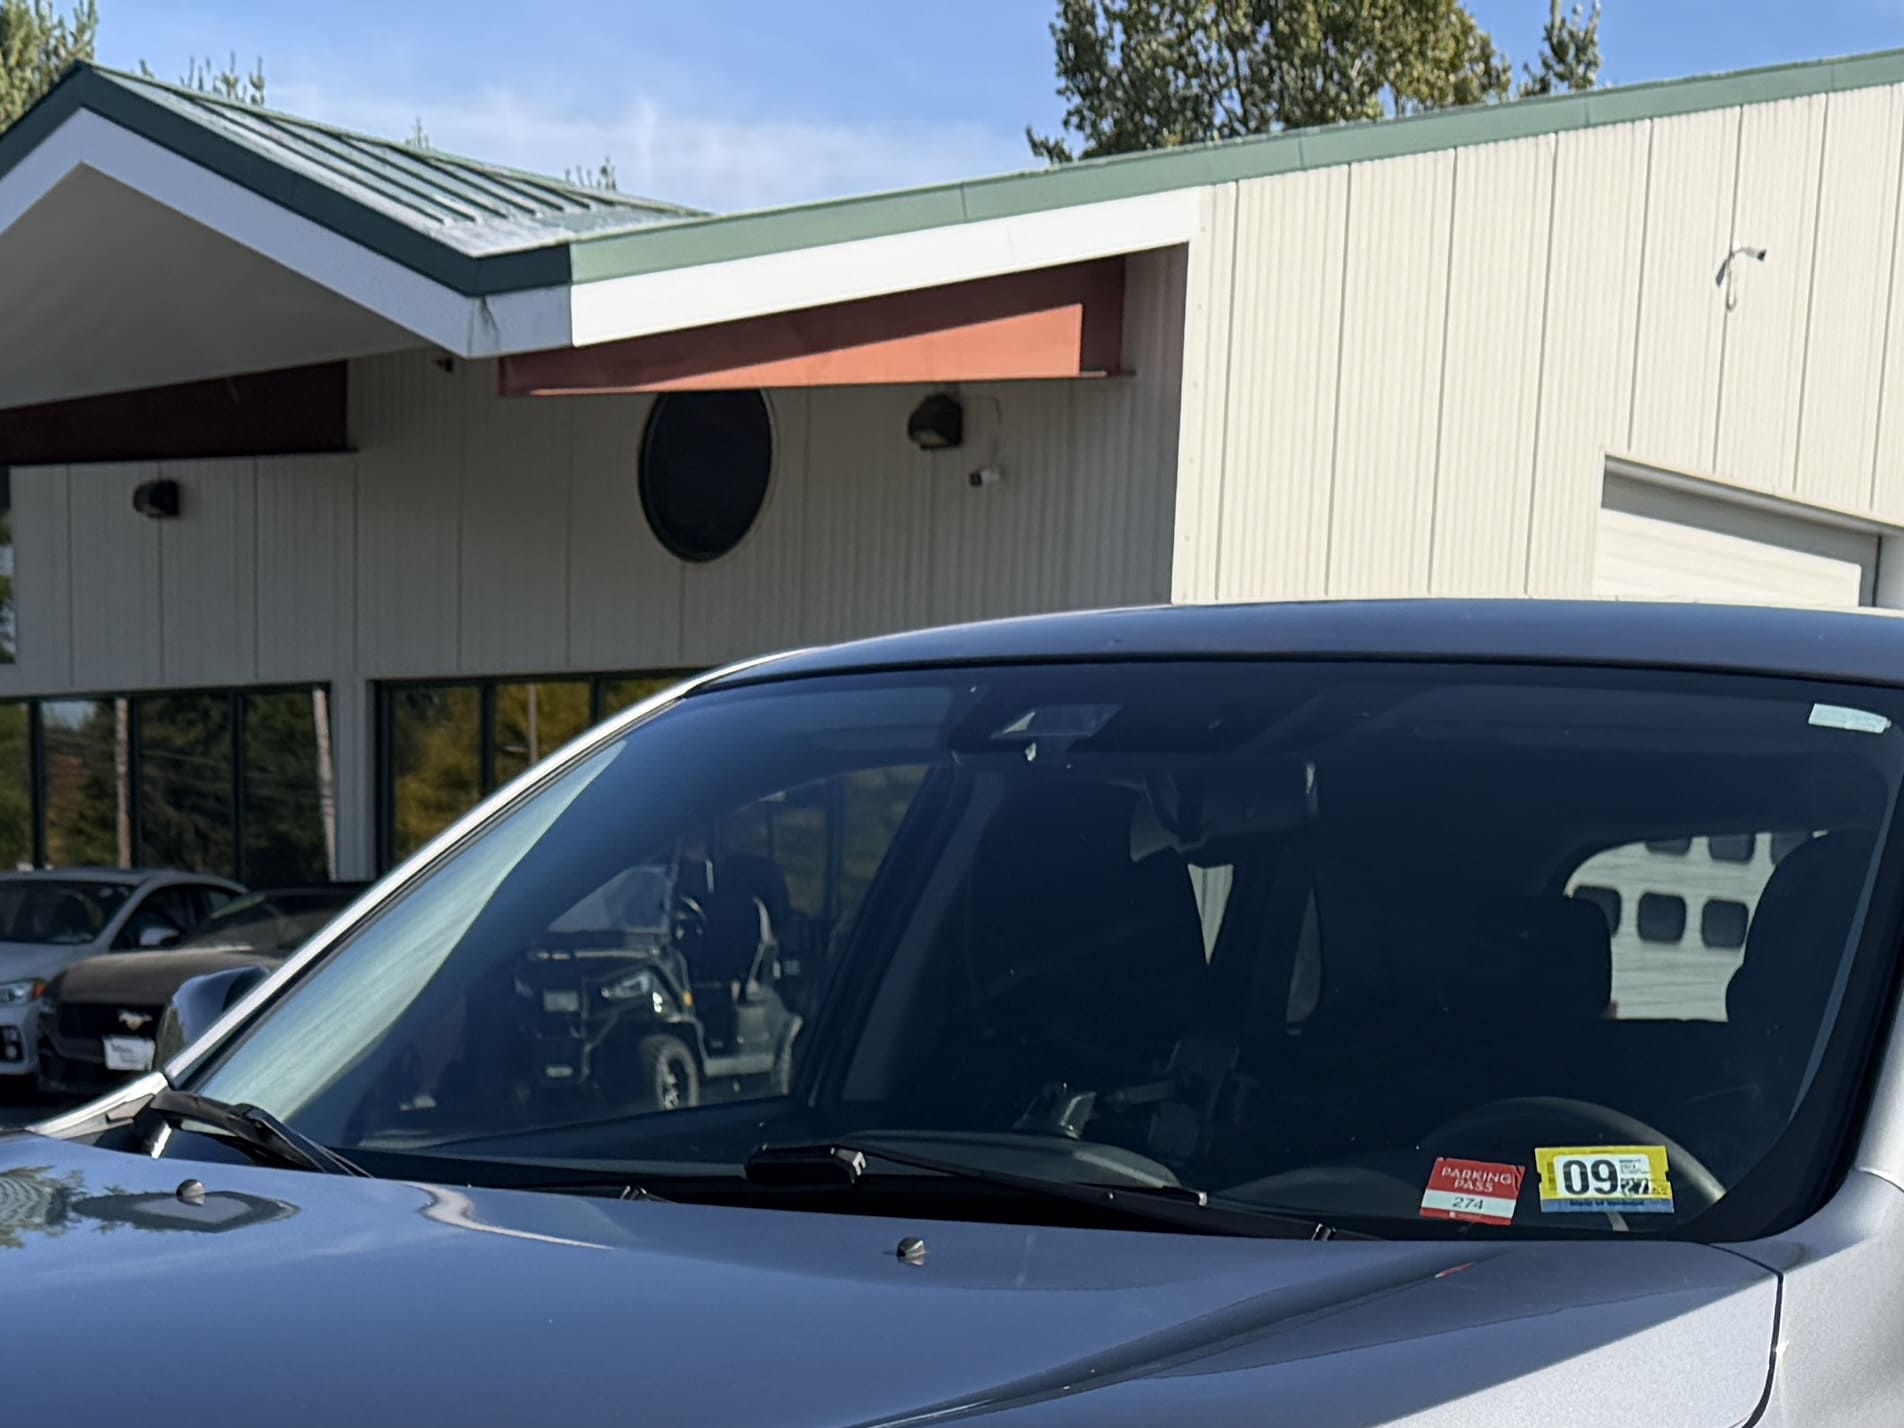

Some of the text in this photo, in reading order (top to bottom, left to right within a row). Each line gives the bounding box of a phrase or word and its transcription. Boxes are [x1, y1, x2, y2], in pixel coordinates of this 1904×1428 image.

[1441, 1166, 1513, 1185] PARKING
[1562, 1158, 1619, 1196] 09
[1454, 1178, 1494, 1193] PASS
[1452, 1196, 1485, 1210] 274
